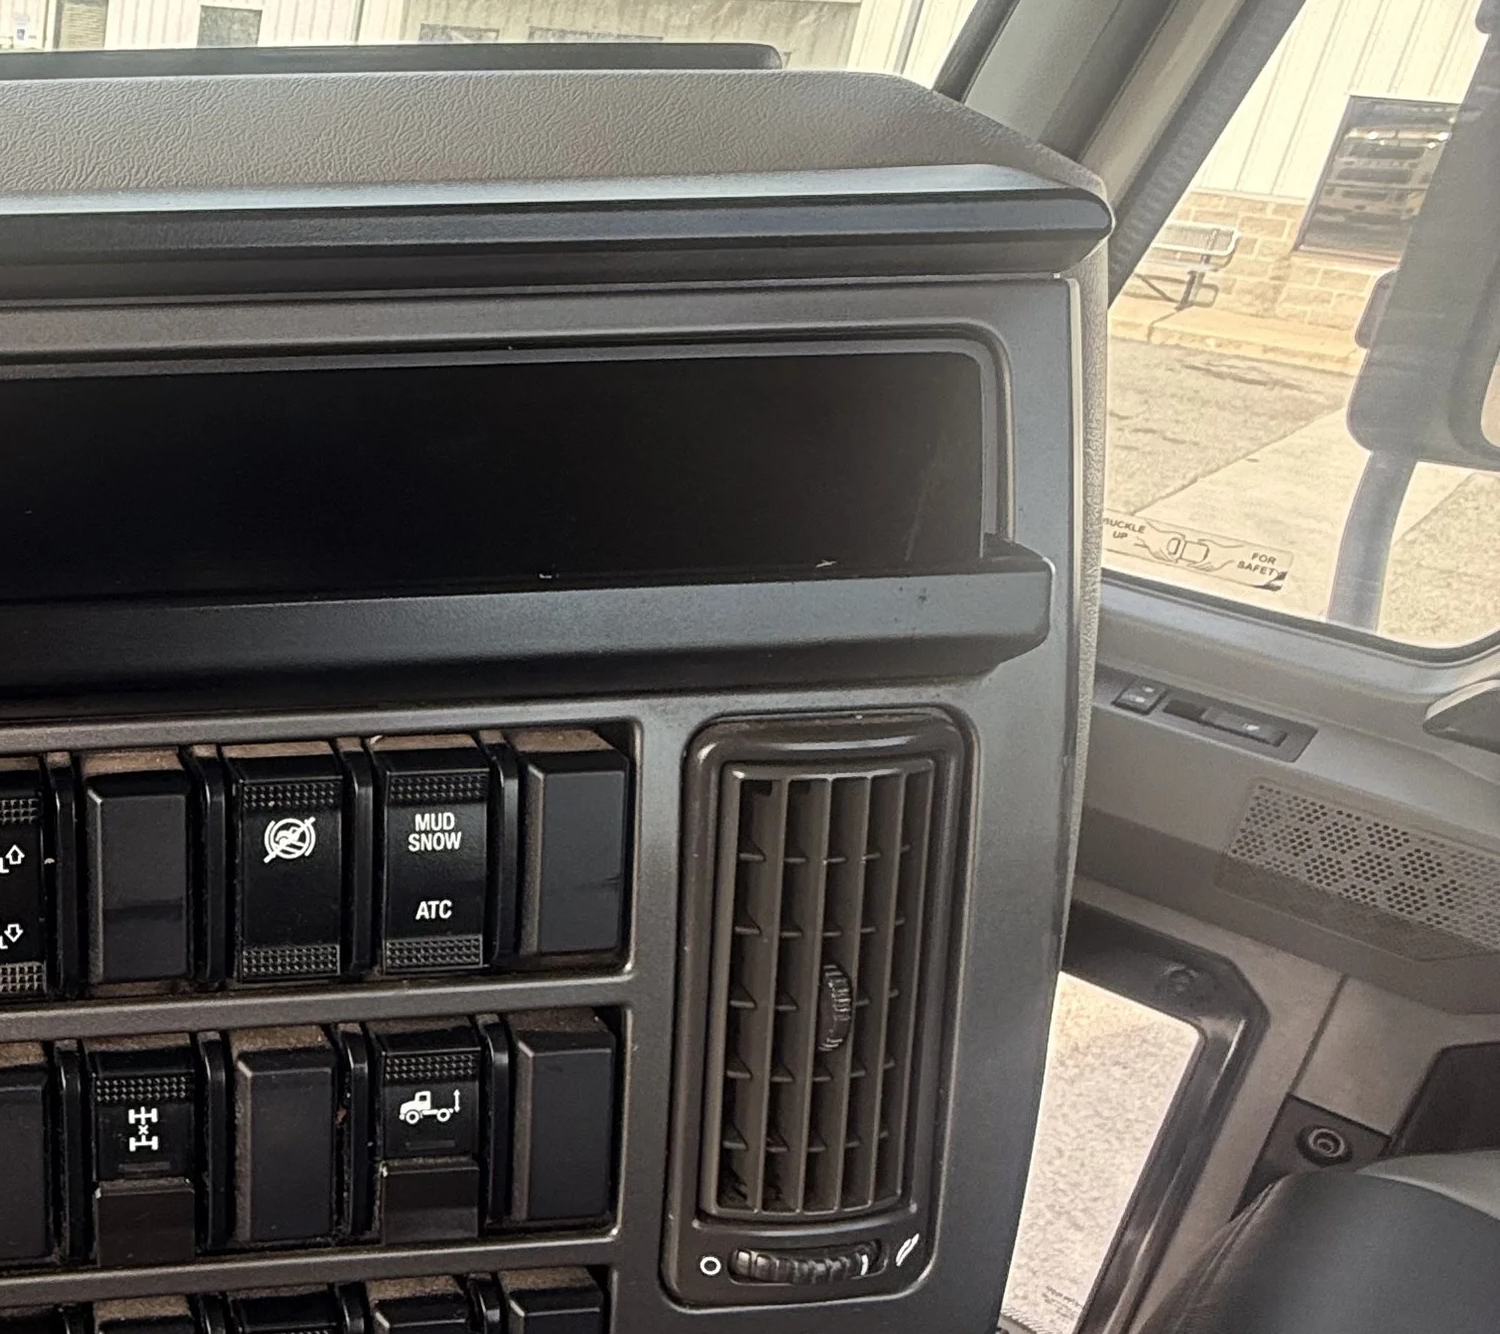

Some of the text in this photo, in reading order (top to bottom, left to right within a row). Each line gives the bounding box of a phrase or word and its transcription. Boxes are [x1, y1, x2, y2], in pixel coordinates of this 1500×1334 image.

[1112, 530, 1128, 539] UP
[1251, 552, 1277, 566] FOR
[1237, 560, 1278, 577] SAFET
[414, 812, 455, 832] MUD
[407, 832, 462, 853] SNOW
[415, 899, 453, 921] ATC
